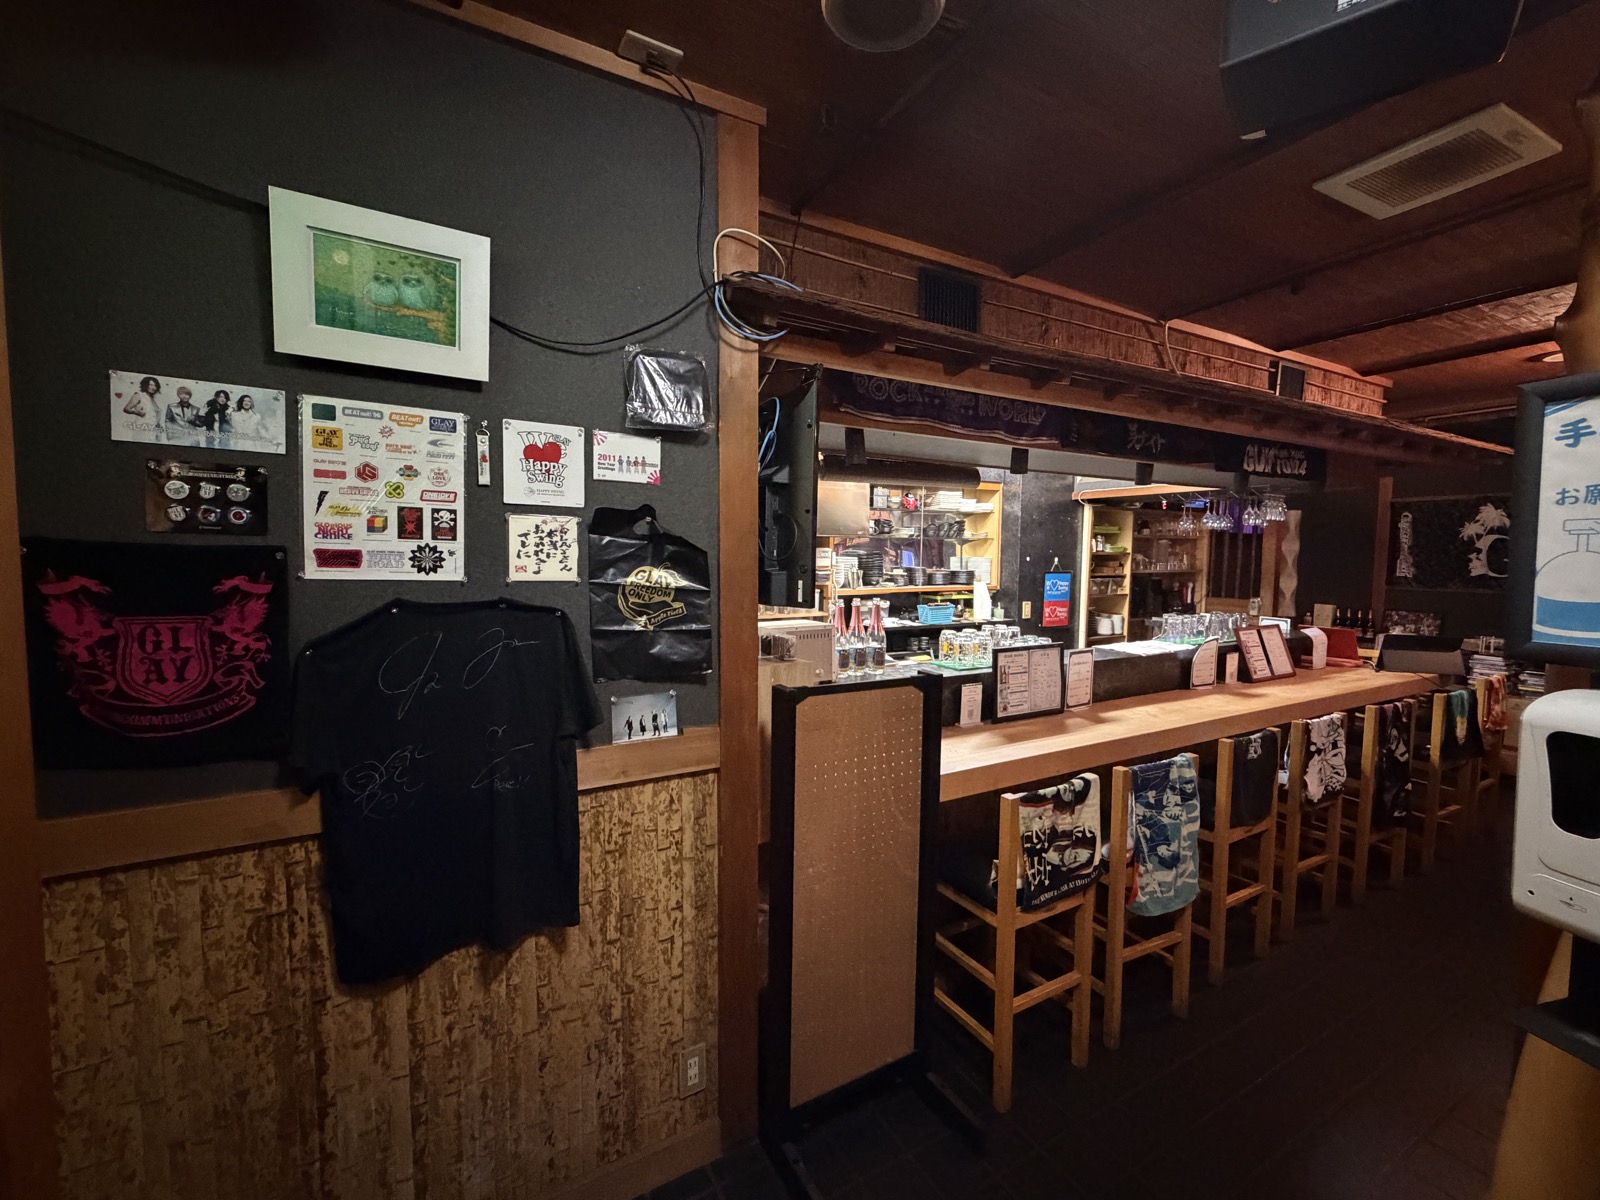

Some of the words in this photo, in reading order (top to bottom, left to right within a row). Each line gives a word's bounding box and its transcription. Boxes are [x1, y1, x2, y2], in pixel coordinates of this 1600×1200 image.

[122, 420, 156, 432] GLAY
[431, 418, 456, 427] GLAY
[315, 428, 340, 436] GLAY
[597, 453, 616, 463] 2011
[519, 458, 568, 477] Happy
[526, 470, 566, 488] Swing
[318, 526, 349, 535] NIGHT
[628, 588, 655, 602] ONLY
[629, 580, 672, 599] FREEDOM
[138, 624, 194, 655] GL
[139, 655, 196, 686] AY
